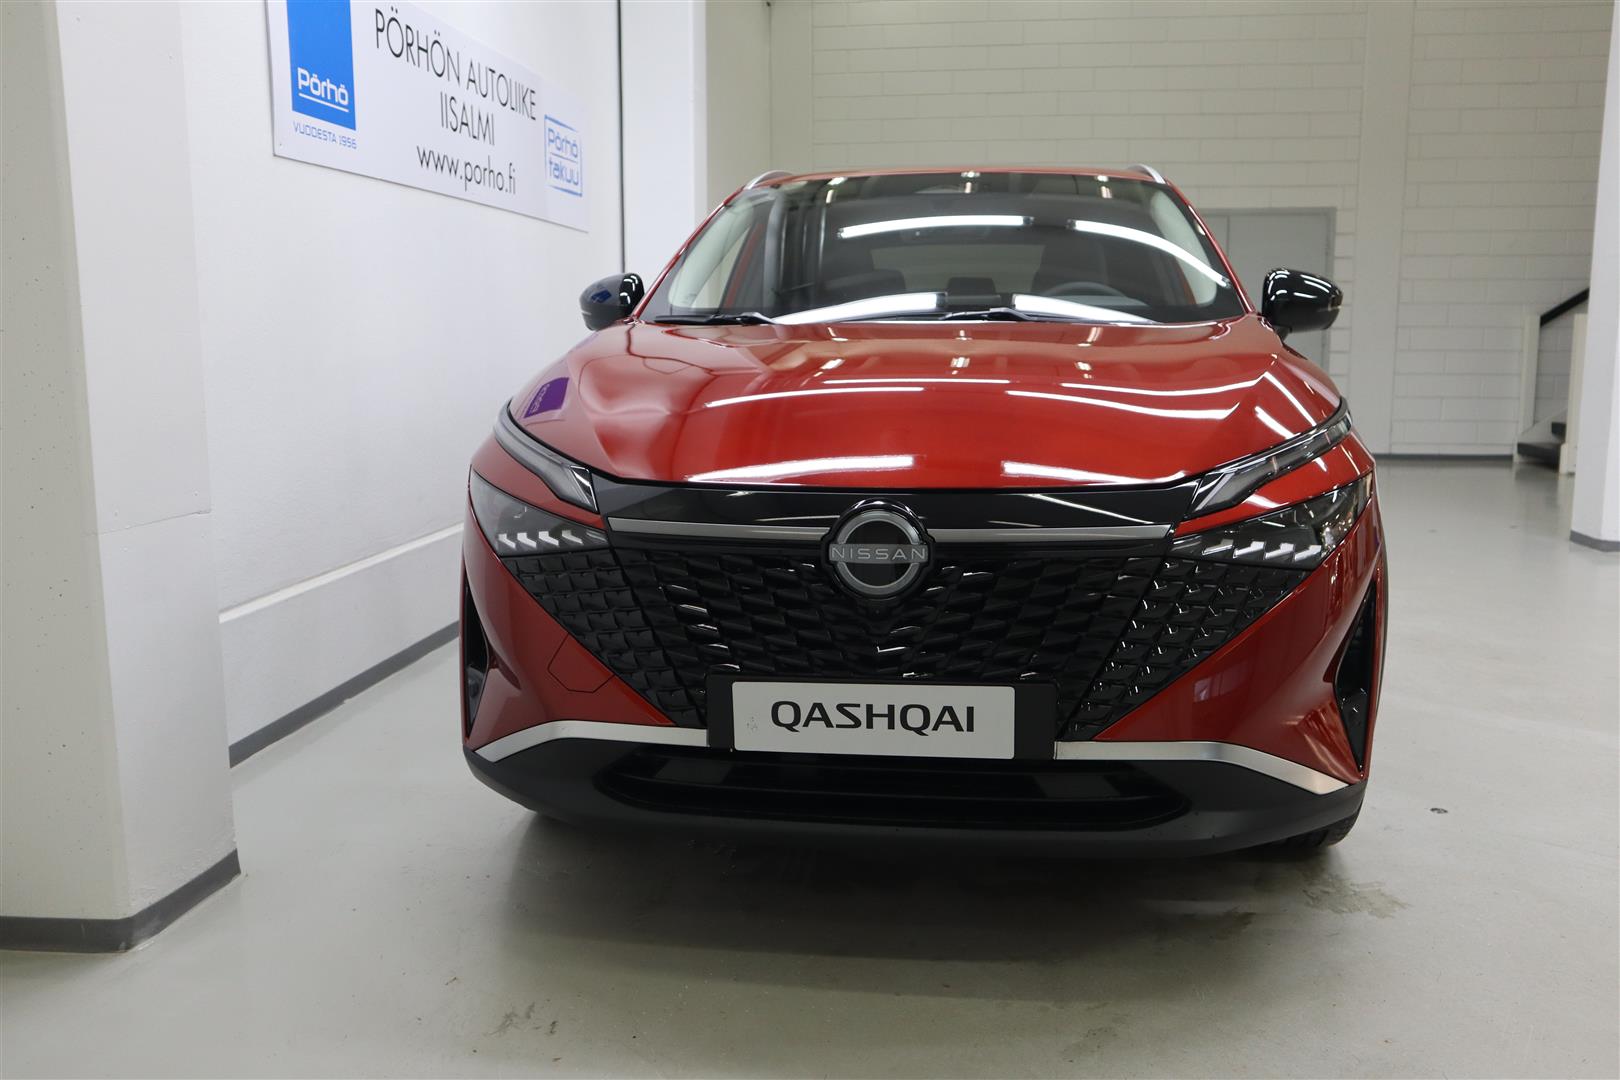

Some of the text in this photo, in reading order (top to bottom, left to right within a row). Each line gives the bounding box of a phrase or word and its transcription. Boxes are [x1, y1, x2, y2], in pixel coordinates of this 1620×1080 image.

[374, 7, 537, 121] PÖRHÖN AUTOLIIKE
[297, 66, 349, 105] Pörhö
[293, 121, 337, 144] VUODESTA
[440, 91, 495, 146] IISALMI
[548, 127, 578, 159] Pörhö
[416, 145, 516, 195] www.porho.fi
[549, 157, 579, 187] takuu
[830, 545, 927, 561] NISSAN
[770, 700, 975, 736] QASHQAI
